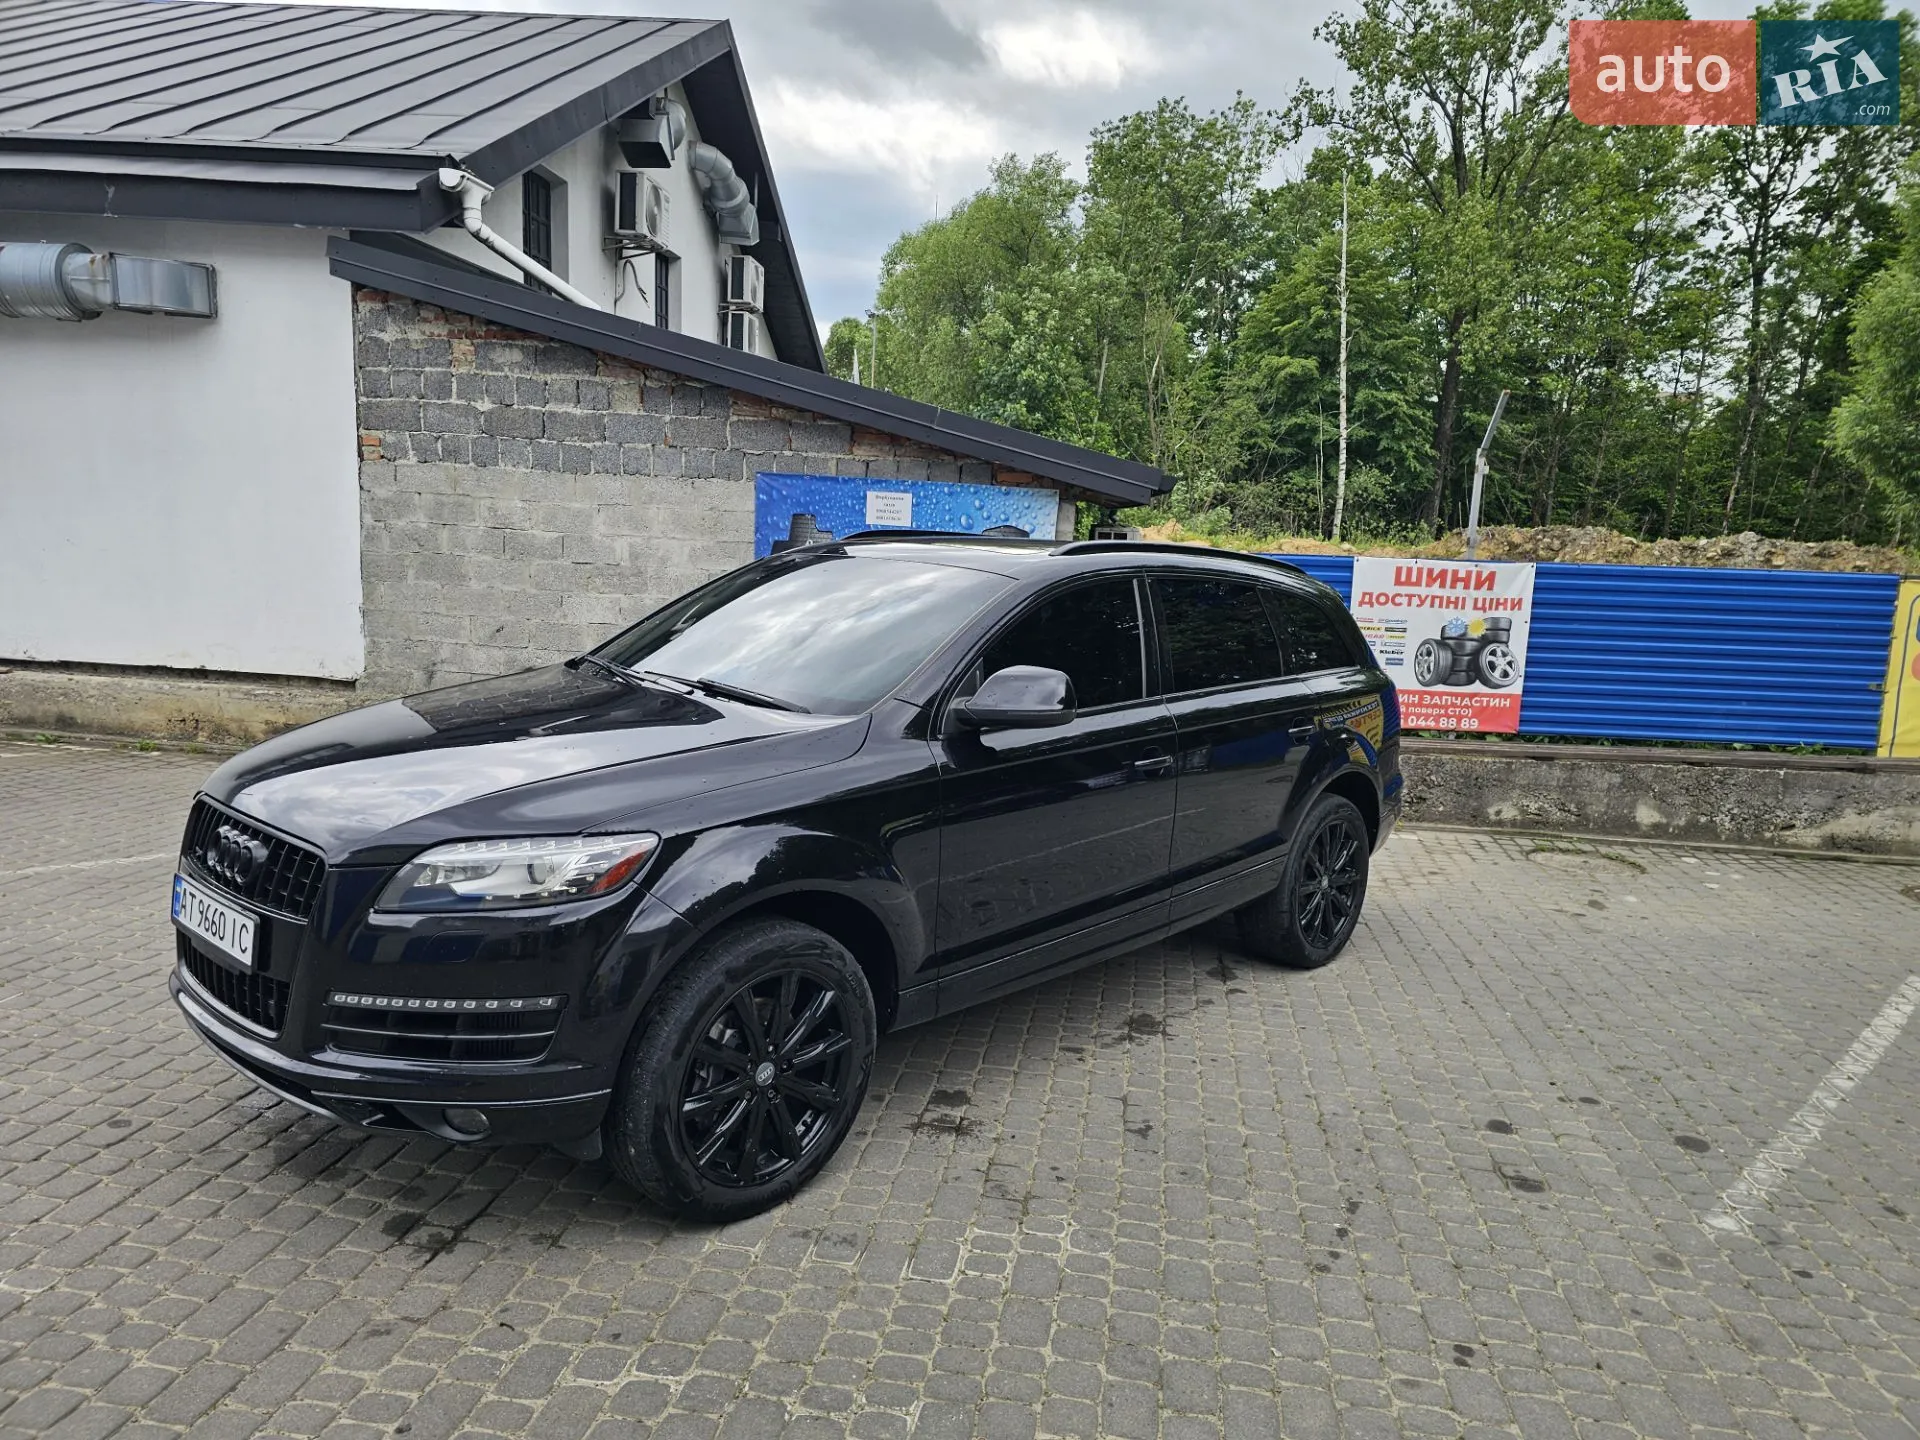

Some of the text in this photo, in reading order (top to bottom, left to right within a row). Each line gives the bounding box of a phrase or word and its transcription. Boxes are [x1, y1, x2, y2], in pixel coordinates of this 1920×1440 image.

[1394, 566, 1497, 591] ШИНИ
[1358, 591, 1523, 613] ДОСТУПНІ ЦІНИ
[1423, 694, 1510, 708] ЗАПЧАСТИН
[1409, 706, 1445, 715] поверх
[1448, 707, 1472, 717] СТО)
[1408, 715, 1436, 727] 044
[1440, 717, 1457, 729] 88
[1461, 718, 1478, 729] 89
[180, 887, 249, 954] AT 9660 IC
